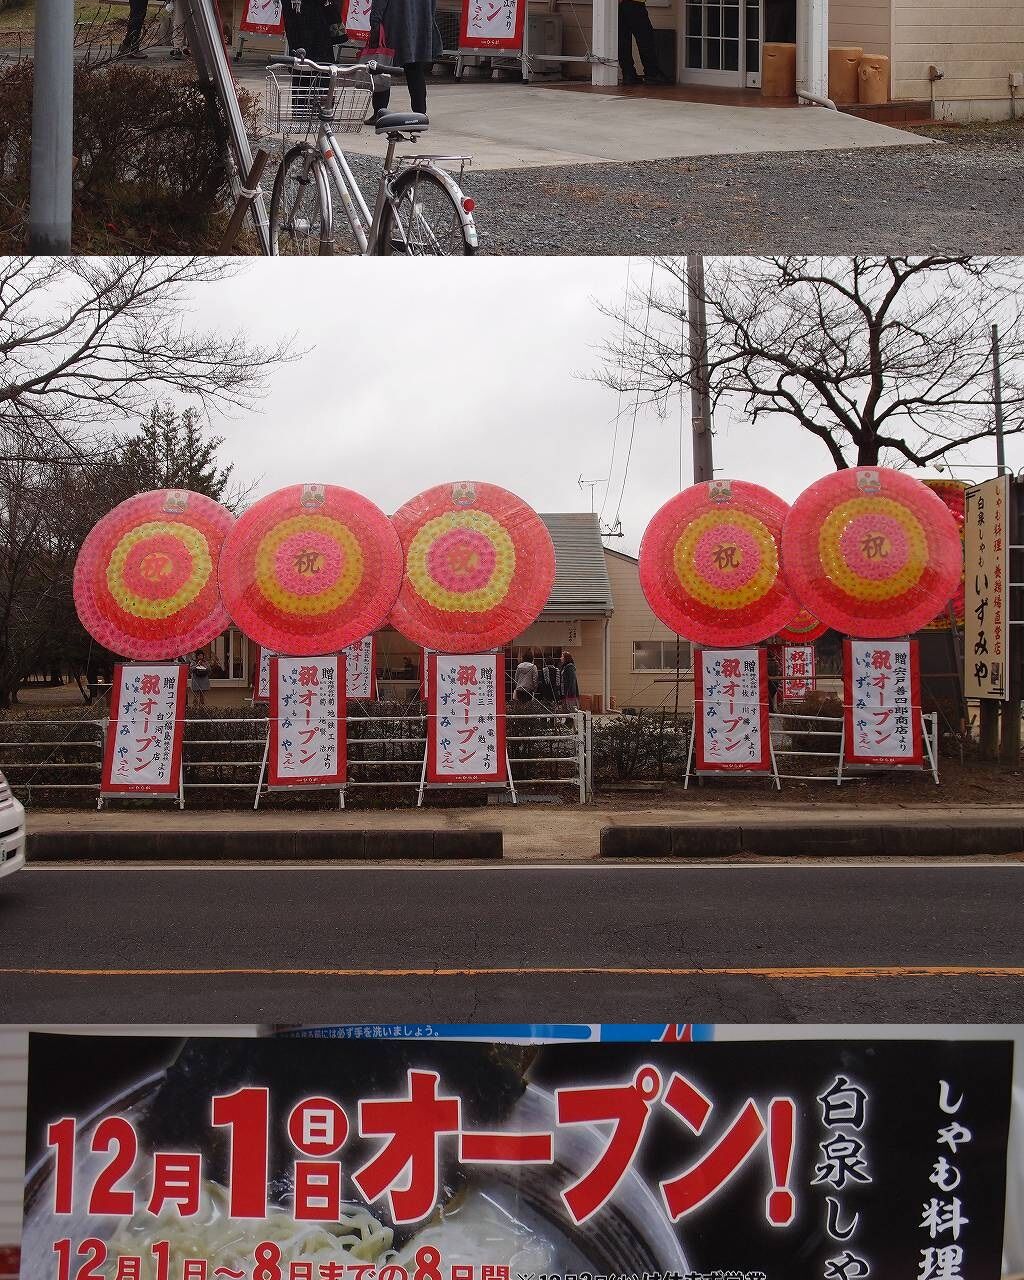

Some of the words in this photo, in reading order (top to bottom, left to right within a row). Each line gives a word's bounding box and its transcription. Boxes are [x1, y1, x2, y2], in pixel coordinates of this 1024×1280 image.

[294, 549, 320, 574] 祝
[713, 544, 740, 570] 祝
[862, 534, 888, 559] 祝
[134, 673, 160, 772] 祝オープン
[298, 665, 320, 764] 祝オープン
[457, 664, 479, 764] 祝オープン
[721, 658, 743, 751] 祝オープン
[871, 650, 893, 744] 祝オープン
